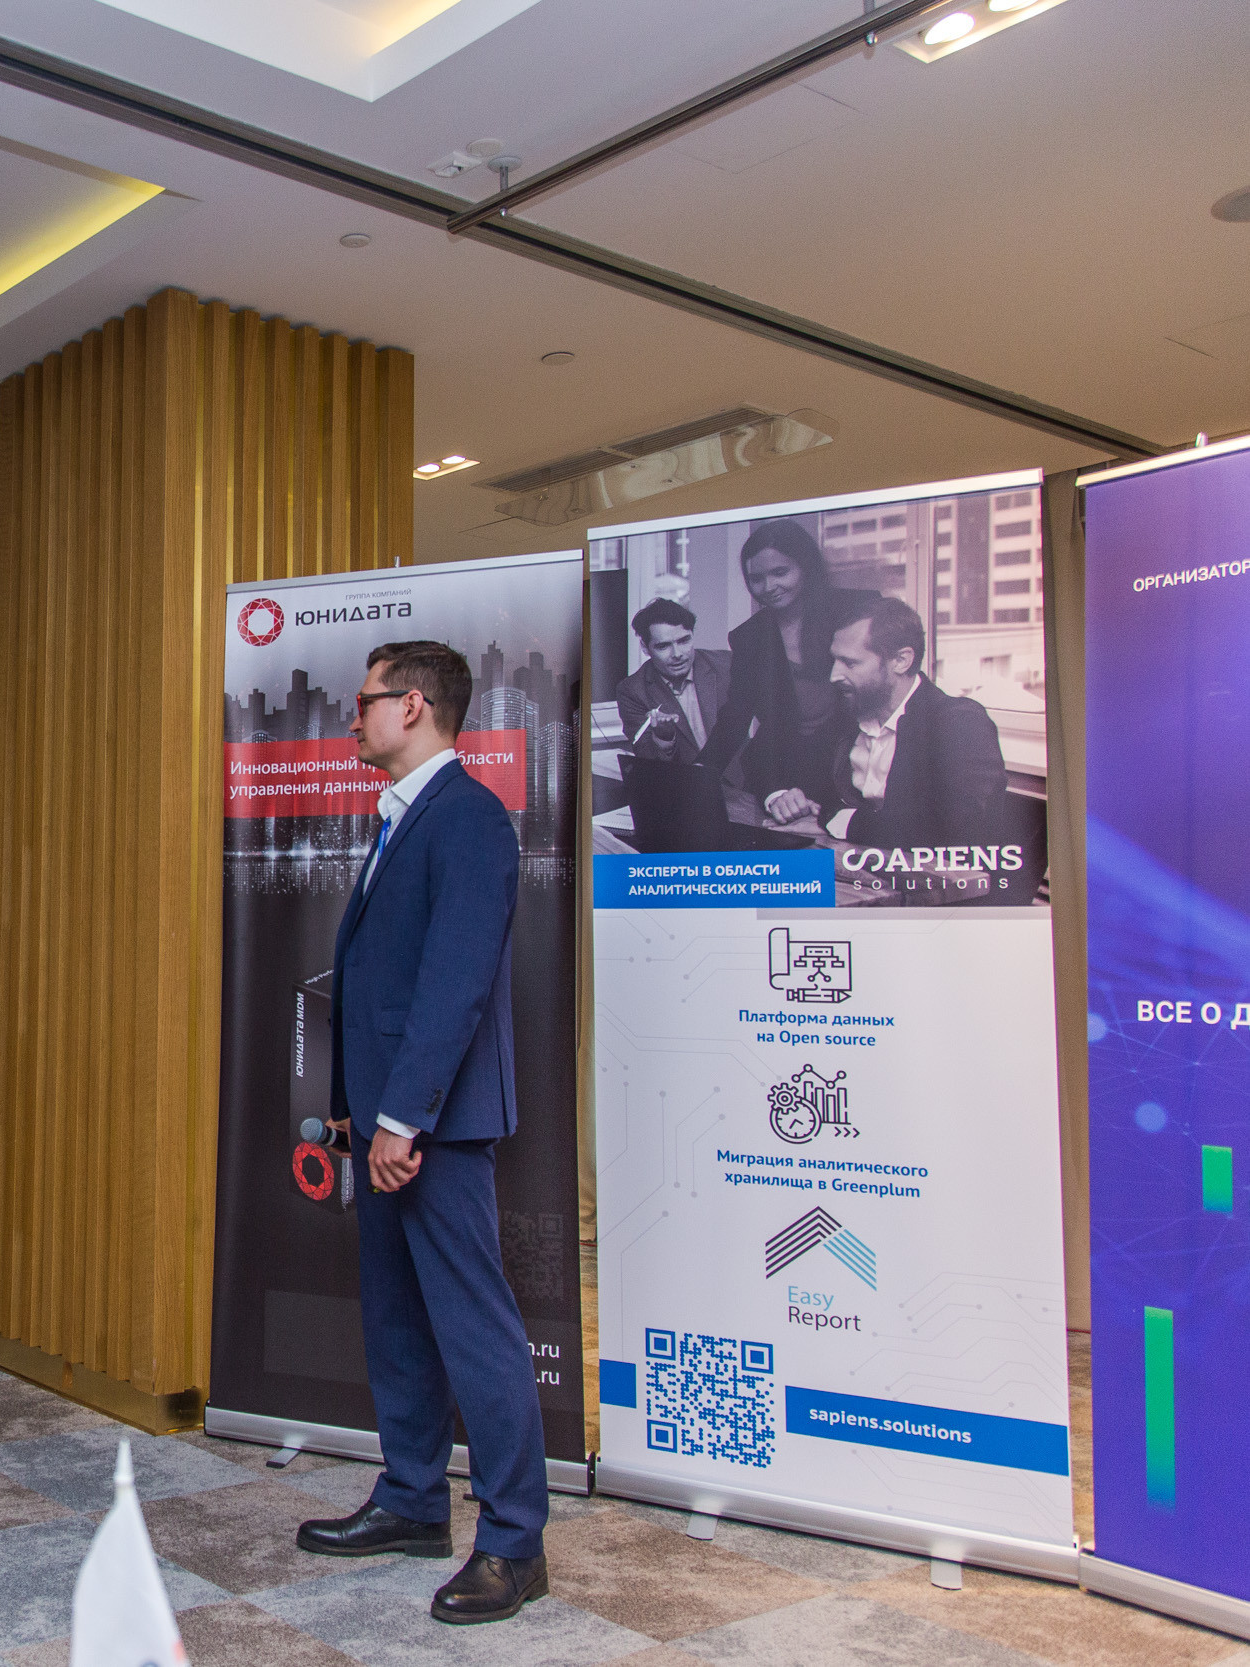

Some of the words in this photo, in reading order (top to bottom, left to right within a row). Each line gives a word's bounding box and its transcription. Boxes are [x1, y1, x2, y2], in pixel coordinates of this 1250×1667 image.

[1133, 559, 1250, 592] ОРГАНИЗАТОР
[346, 592, 370, 600] ГРУППА
[372, 588, 412, 598] КОМПАНИЙ
[231, 756, 357, 775] Инновационный
[456, 750, 513, 766] бласти
[230, 783, 320, 800] управления
[842, 845, 1023, 872] SAPIENS
[628, 866, 698, 878] ЭКСПЕРТЫ
[703, 866, 711, 877] В
[715, 864, 780, 876] ОБЛАСТИ
[853, 876, 1009, 890] solutions
[628, 883, 747, 895] АНАЛИТИЧЕСКИХ
[751, 880, 821, 895] РЕШЕНИЙ
[739, 1010, 827, 1026] Платформа
[832, 1015, 894, 1027] данных
[1137, 1000, 1192, 1023] ВСЕ
[1200, 1002, 1221, 1024] О
[757, 1032, 774, 1042] на
[779, 1030, 820, 1046] Open
[825, 1034, 876, 1046] source
[716, 1149, 794, 1167] Миграция
[798, 1158, 928, 1177] аналитического
[725, 1172, 813, 1190] хранилища
[818, 1180, 827, 1190] в
[832, 1178, 920, 1198] Greenplum
[788, 1285, 834, 1311] Easy
[788, 1306, 861, 1331] Report
[809, 1408, 972, 1443] sapiens.solutions
